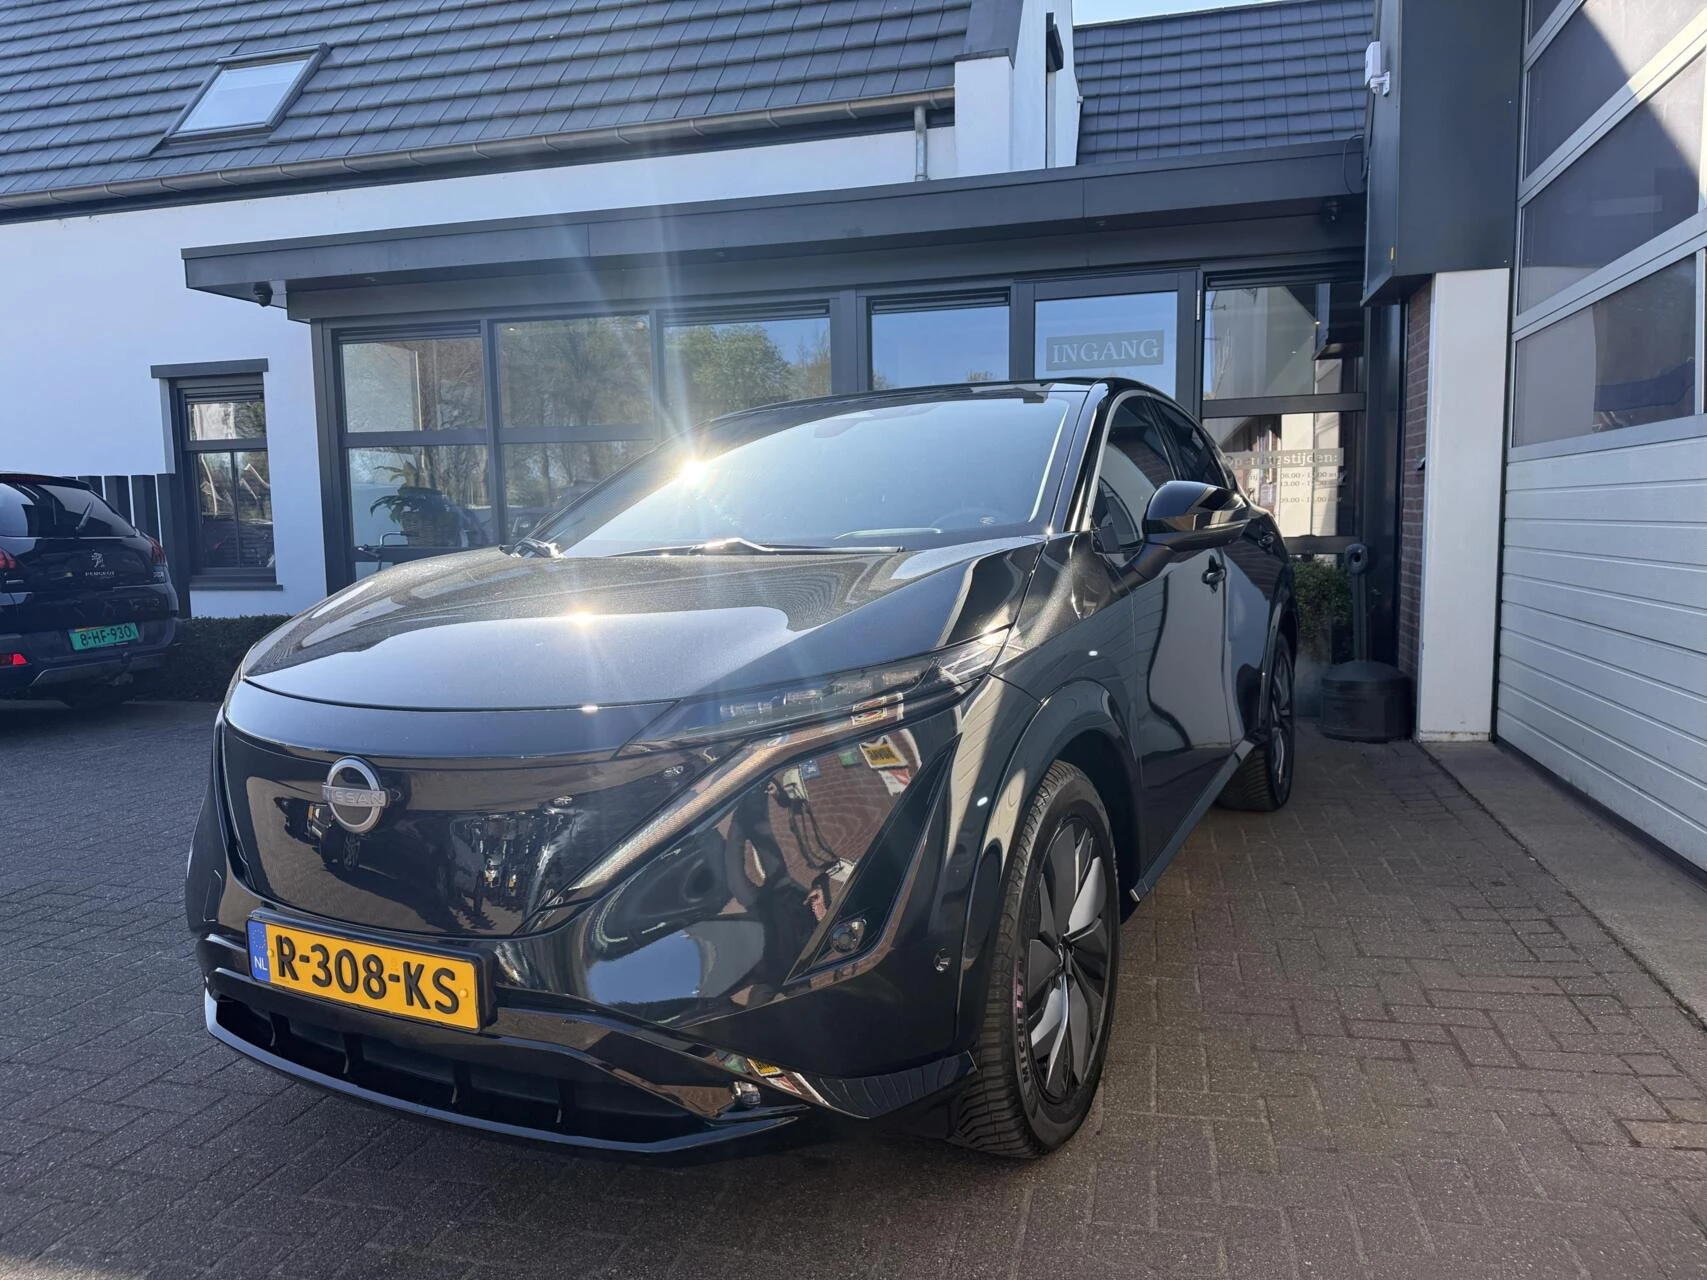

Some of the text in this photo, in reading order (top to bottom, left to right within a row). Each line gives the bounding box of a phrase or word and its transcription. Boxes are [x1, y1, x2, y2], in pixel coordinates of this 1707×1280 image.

[1052, 338, 1160, 364] INGANG
[80, 625, 132, 647] 8-HF-930
[322, 786, 384, 806] NISSAN
[254, 955, 268, 971] NL
[275, 934, 459, 1015] R-308-KS
